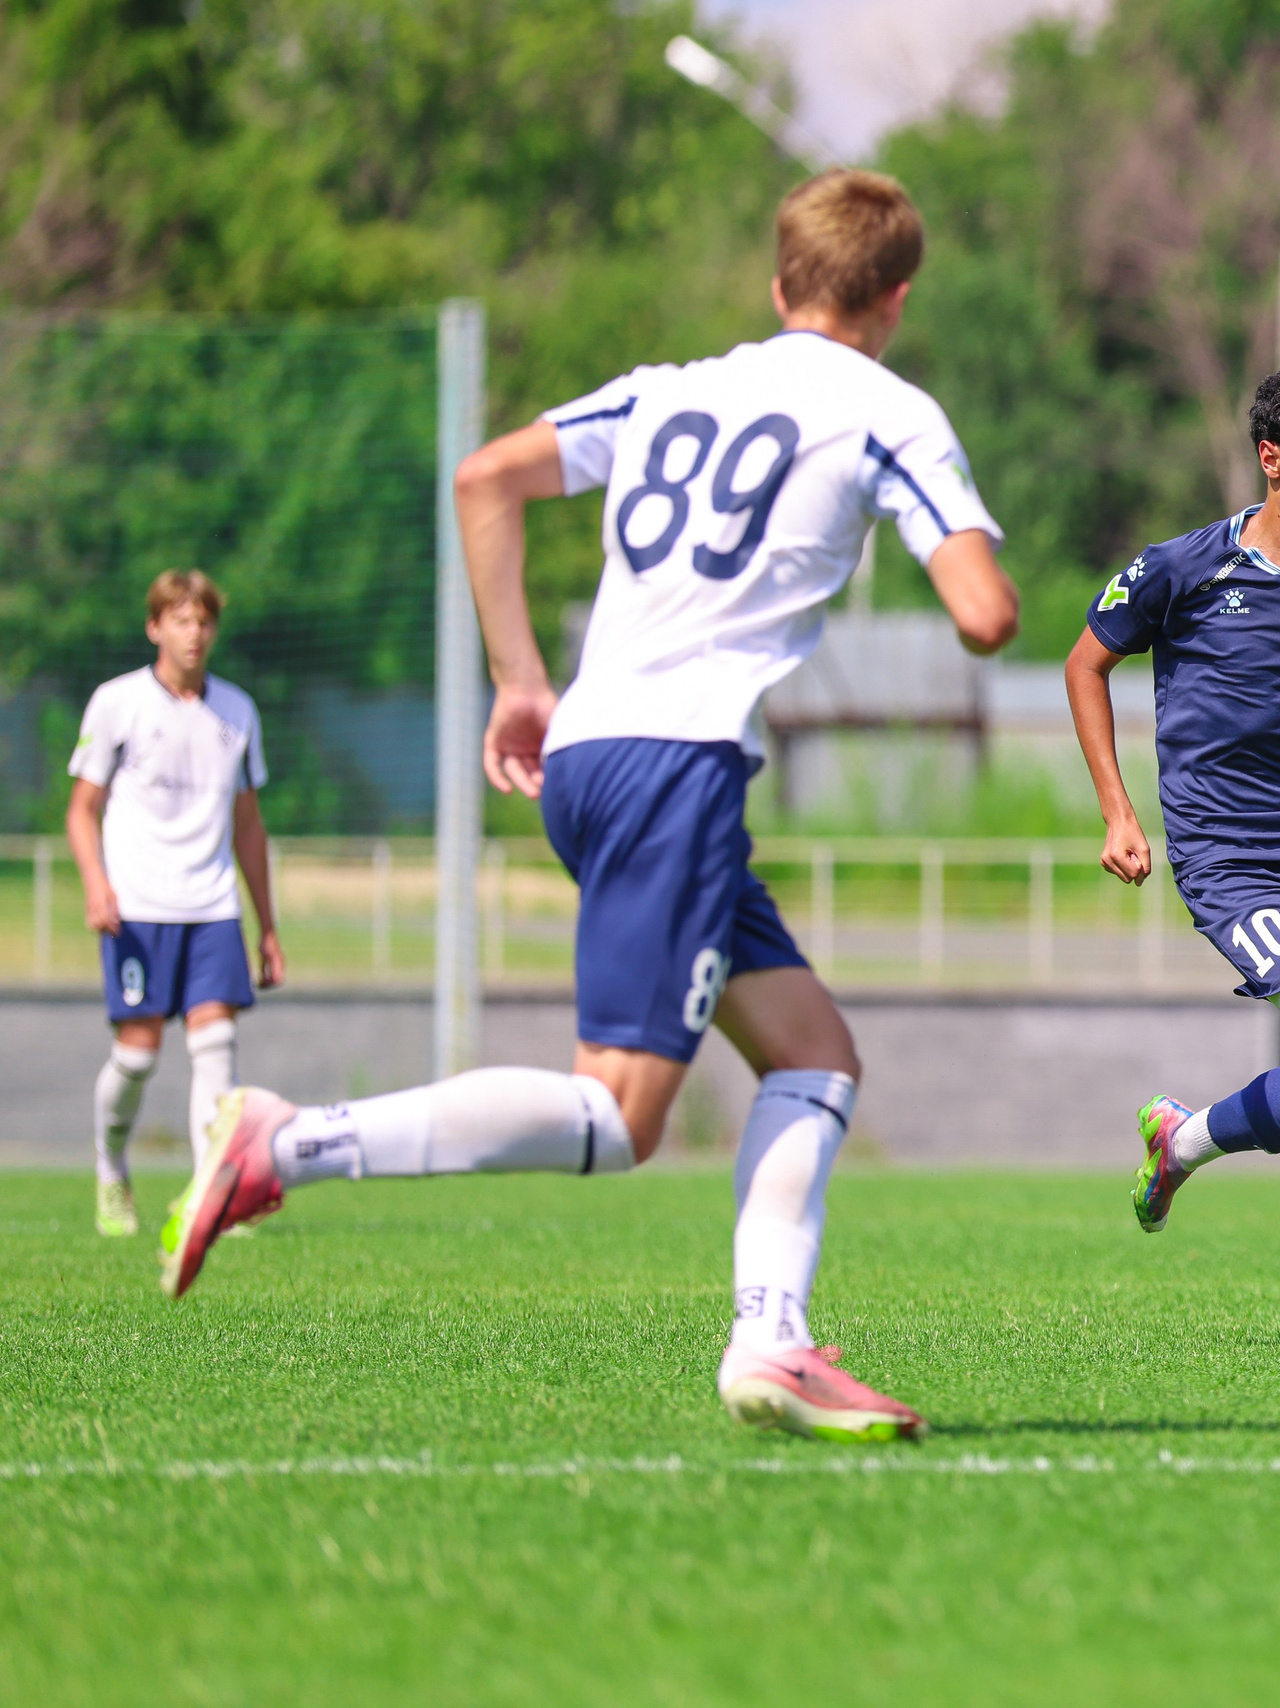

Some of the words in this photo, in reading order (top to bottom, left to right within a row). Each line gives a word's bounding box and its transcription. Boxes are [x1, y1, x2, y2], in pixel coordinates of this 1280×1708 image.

[617, 411, 800, 579] 89
[120, 956, 146, 1007] 9
[682, 946, 732, 1034] 8
